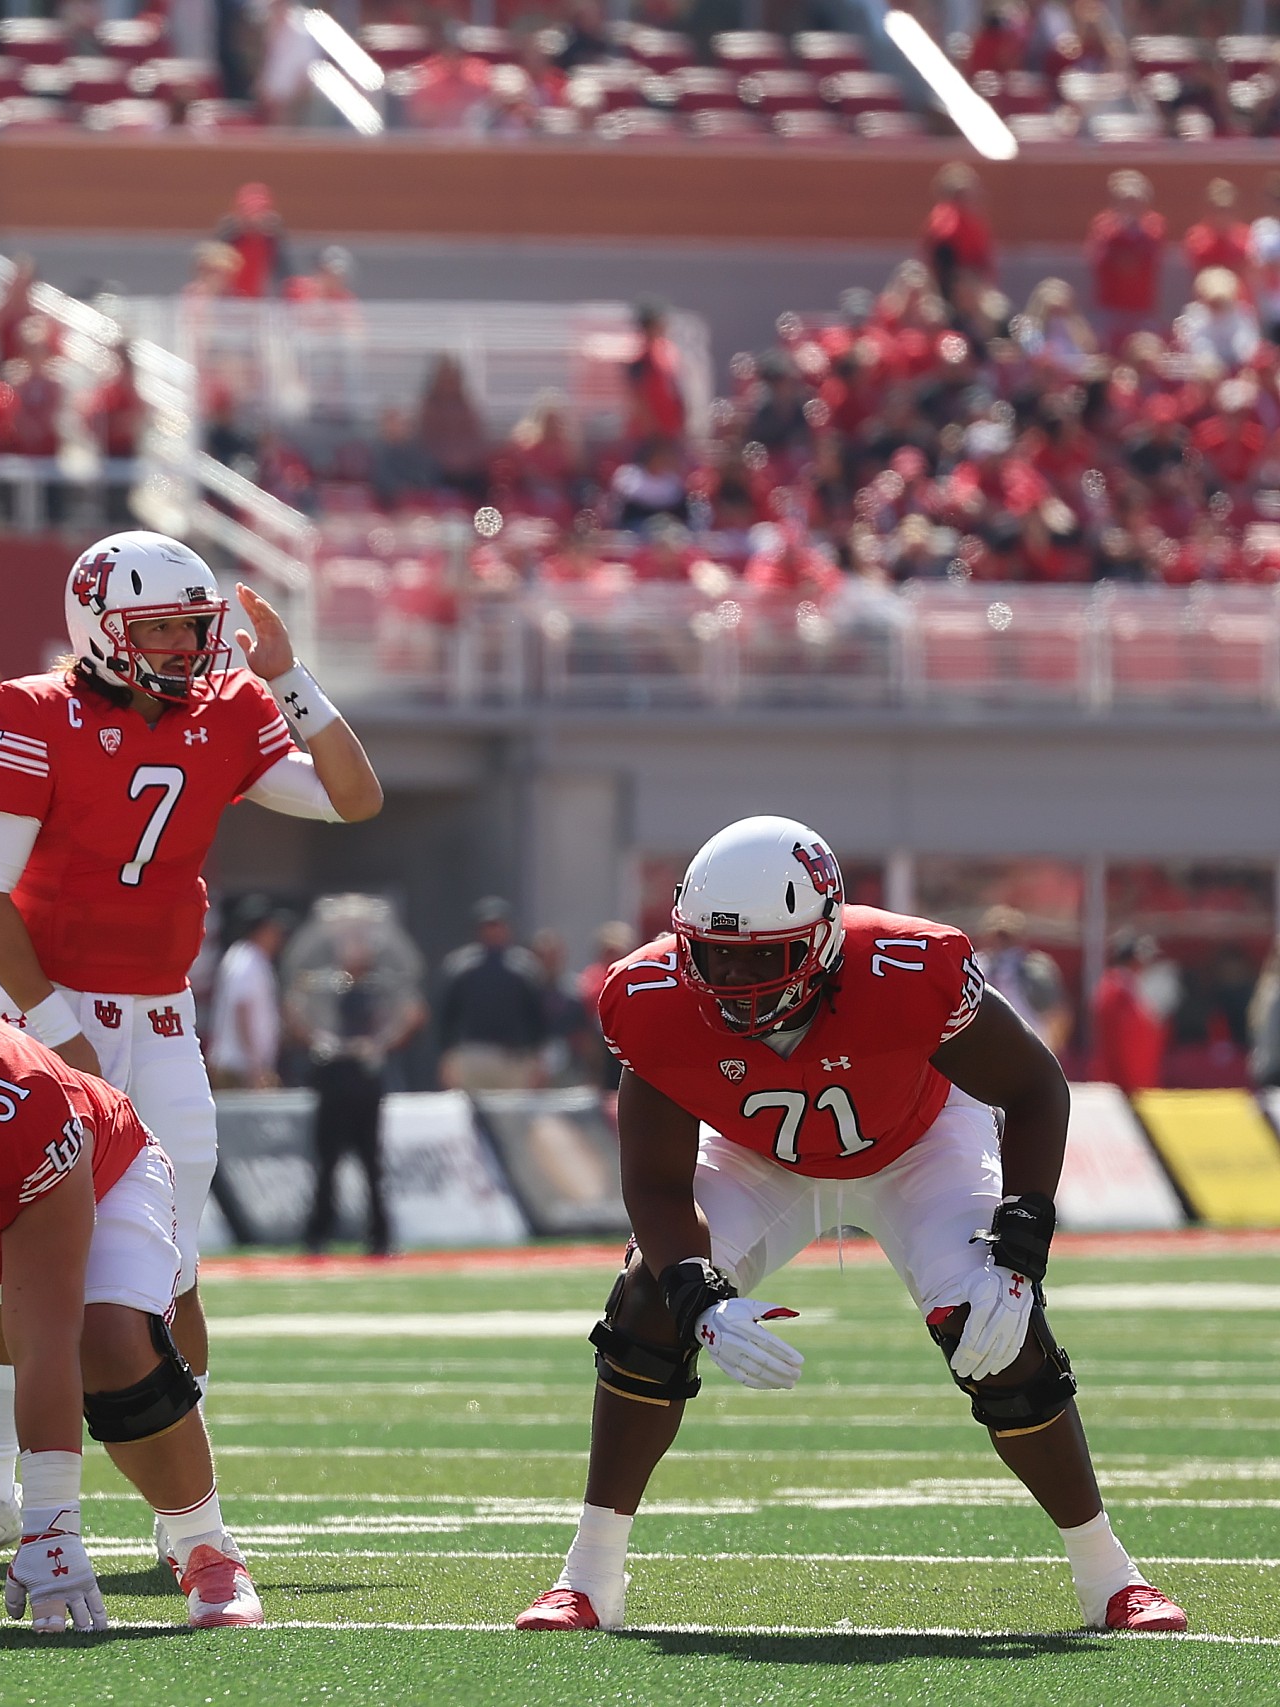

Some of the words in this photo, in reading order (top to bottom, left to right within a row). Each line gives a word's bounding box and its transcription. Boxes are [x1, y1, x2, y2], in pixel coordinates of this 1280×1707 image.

[68, 697, 83, 729] C
[120, 763, 186, 887] 7
[626, 952, 678, 994] 71
[872, 938, 928, 976] 71
[739, 1086, 874, 1163] 71
